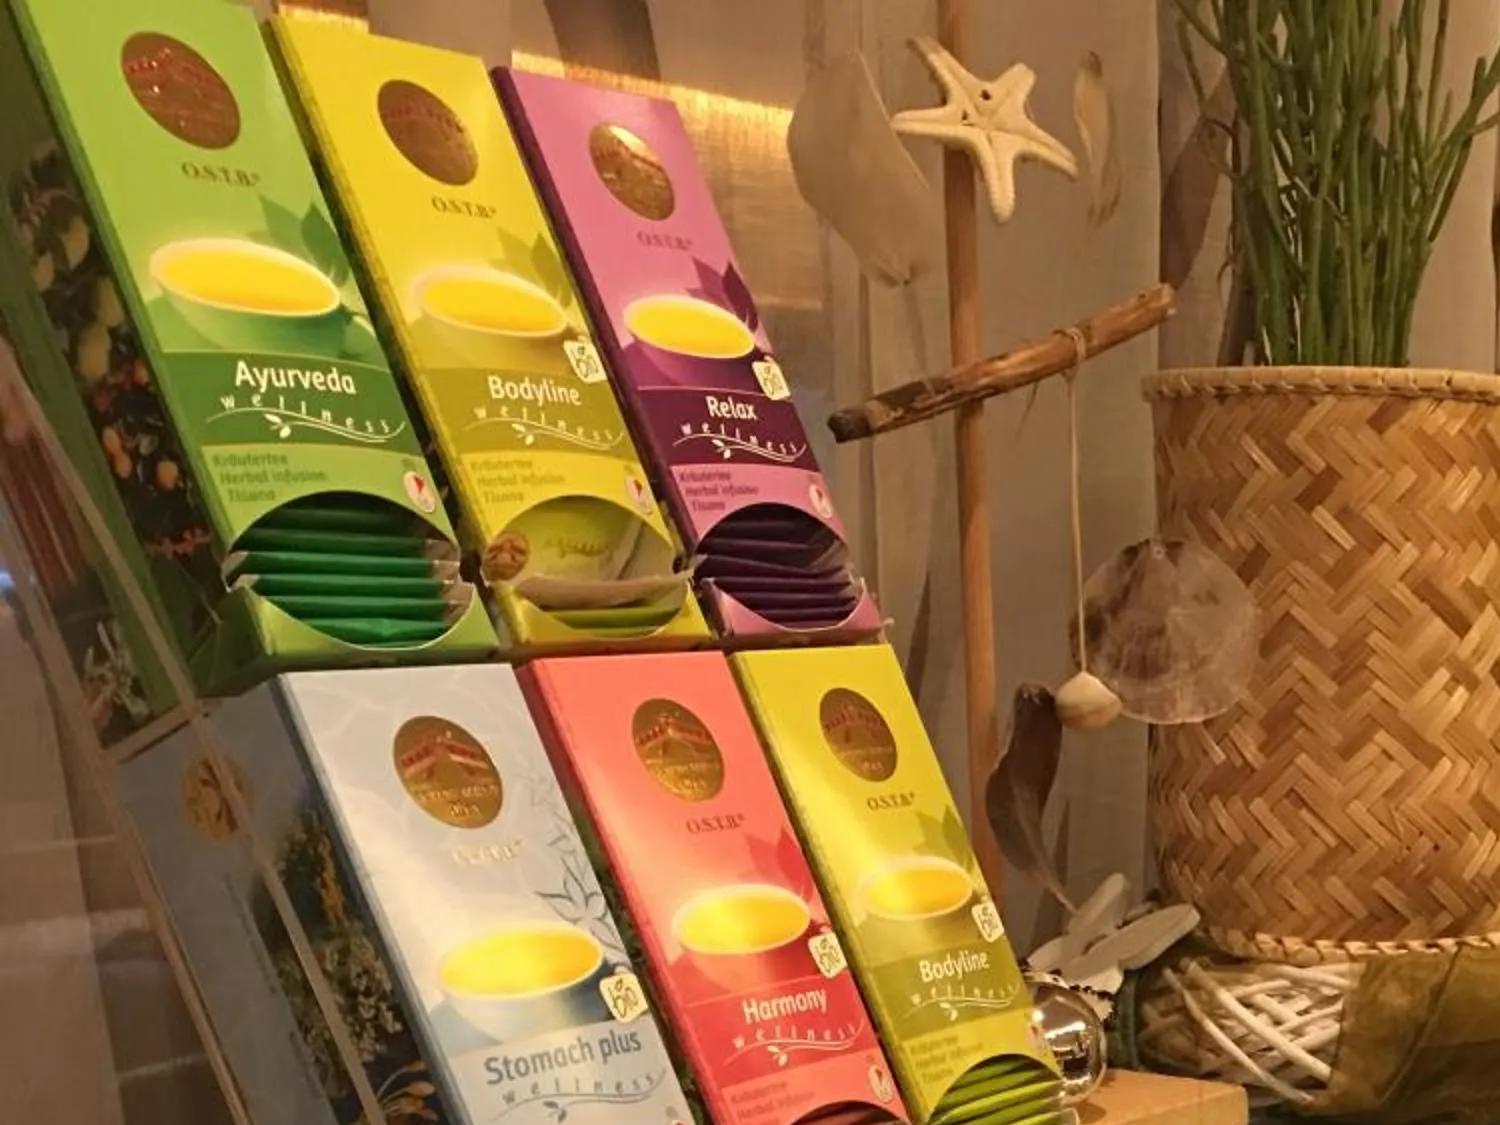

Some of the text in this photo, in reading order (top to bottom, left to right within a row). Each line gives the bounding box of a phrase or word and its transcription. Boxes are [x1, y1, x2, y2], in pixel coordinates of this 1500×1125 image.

[235, 360, 356, 394] Ayurveda
[487, 375, 582, 406] Bodyline
[219, 394, 391, 434] wellness
[473, 406, 613, 441] wellness
[705, 396, 757, 420] Relax
[680, 421, 798, 455] wellness
[918, 950, 991, 983] Bodyline
[742, 989, 828, 1024] Harmony
[732, 1022, 856, 1049] wellness
[484, 1029, 642, 1086] Stomach plus
[502, 1074, 655, 1105] wellness
